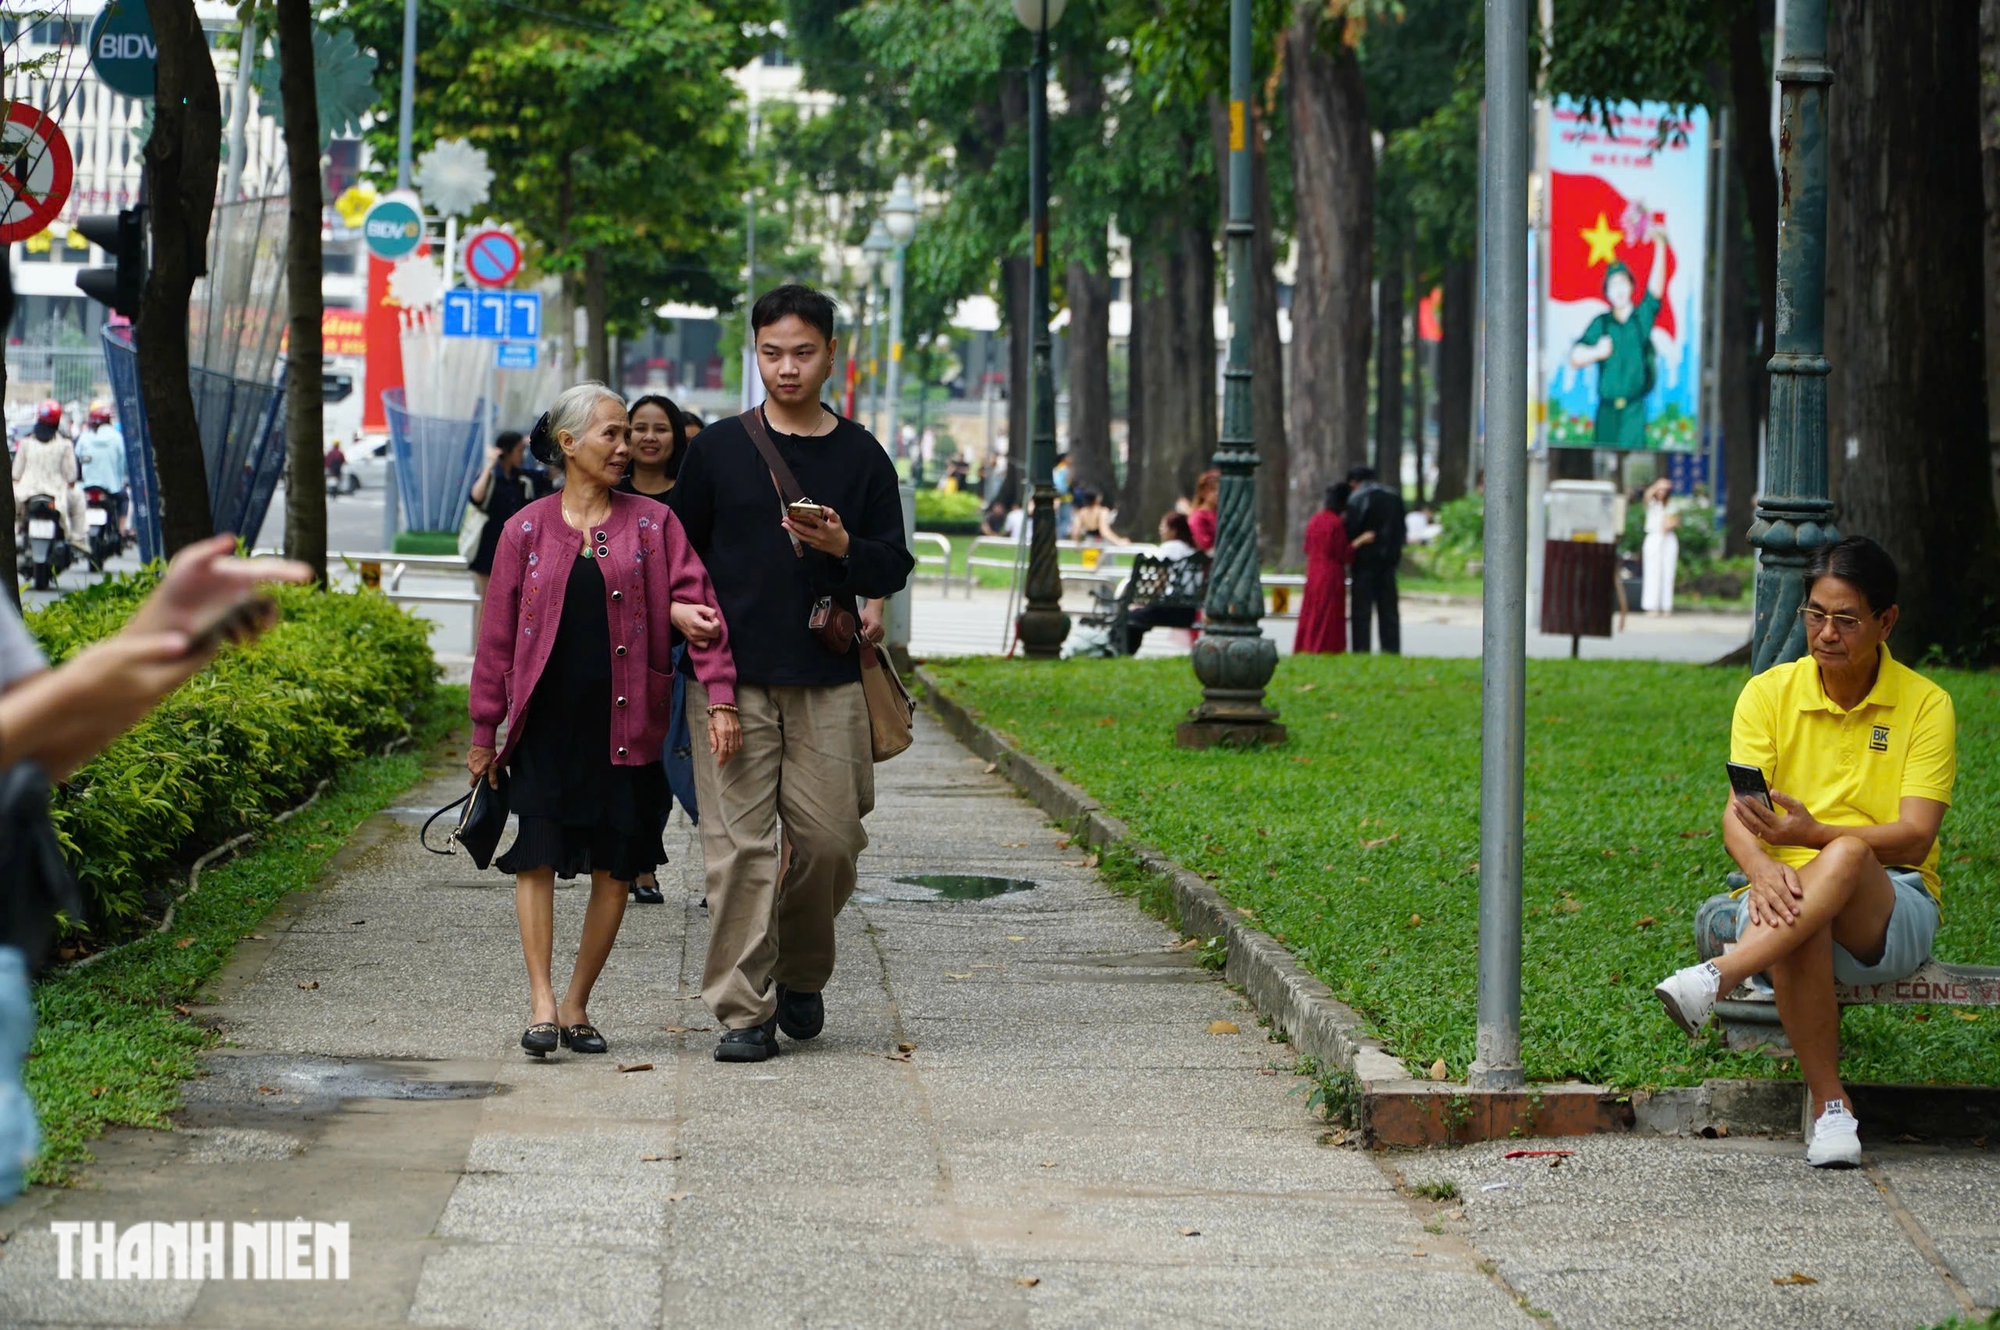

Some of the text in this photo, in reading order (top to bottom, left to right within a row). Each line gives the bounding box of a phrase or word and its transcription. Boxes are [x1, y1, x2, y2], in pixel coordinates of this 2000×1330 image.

[98, 33, 158, 59] BIDV
[367, 219, 406, 239] BIDV
[1873, 729, 1889, 743] BK
[1895, 975, 1968, 1000] CÔNG
